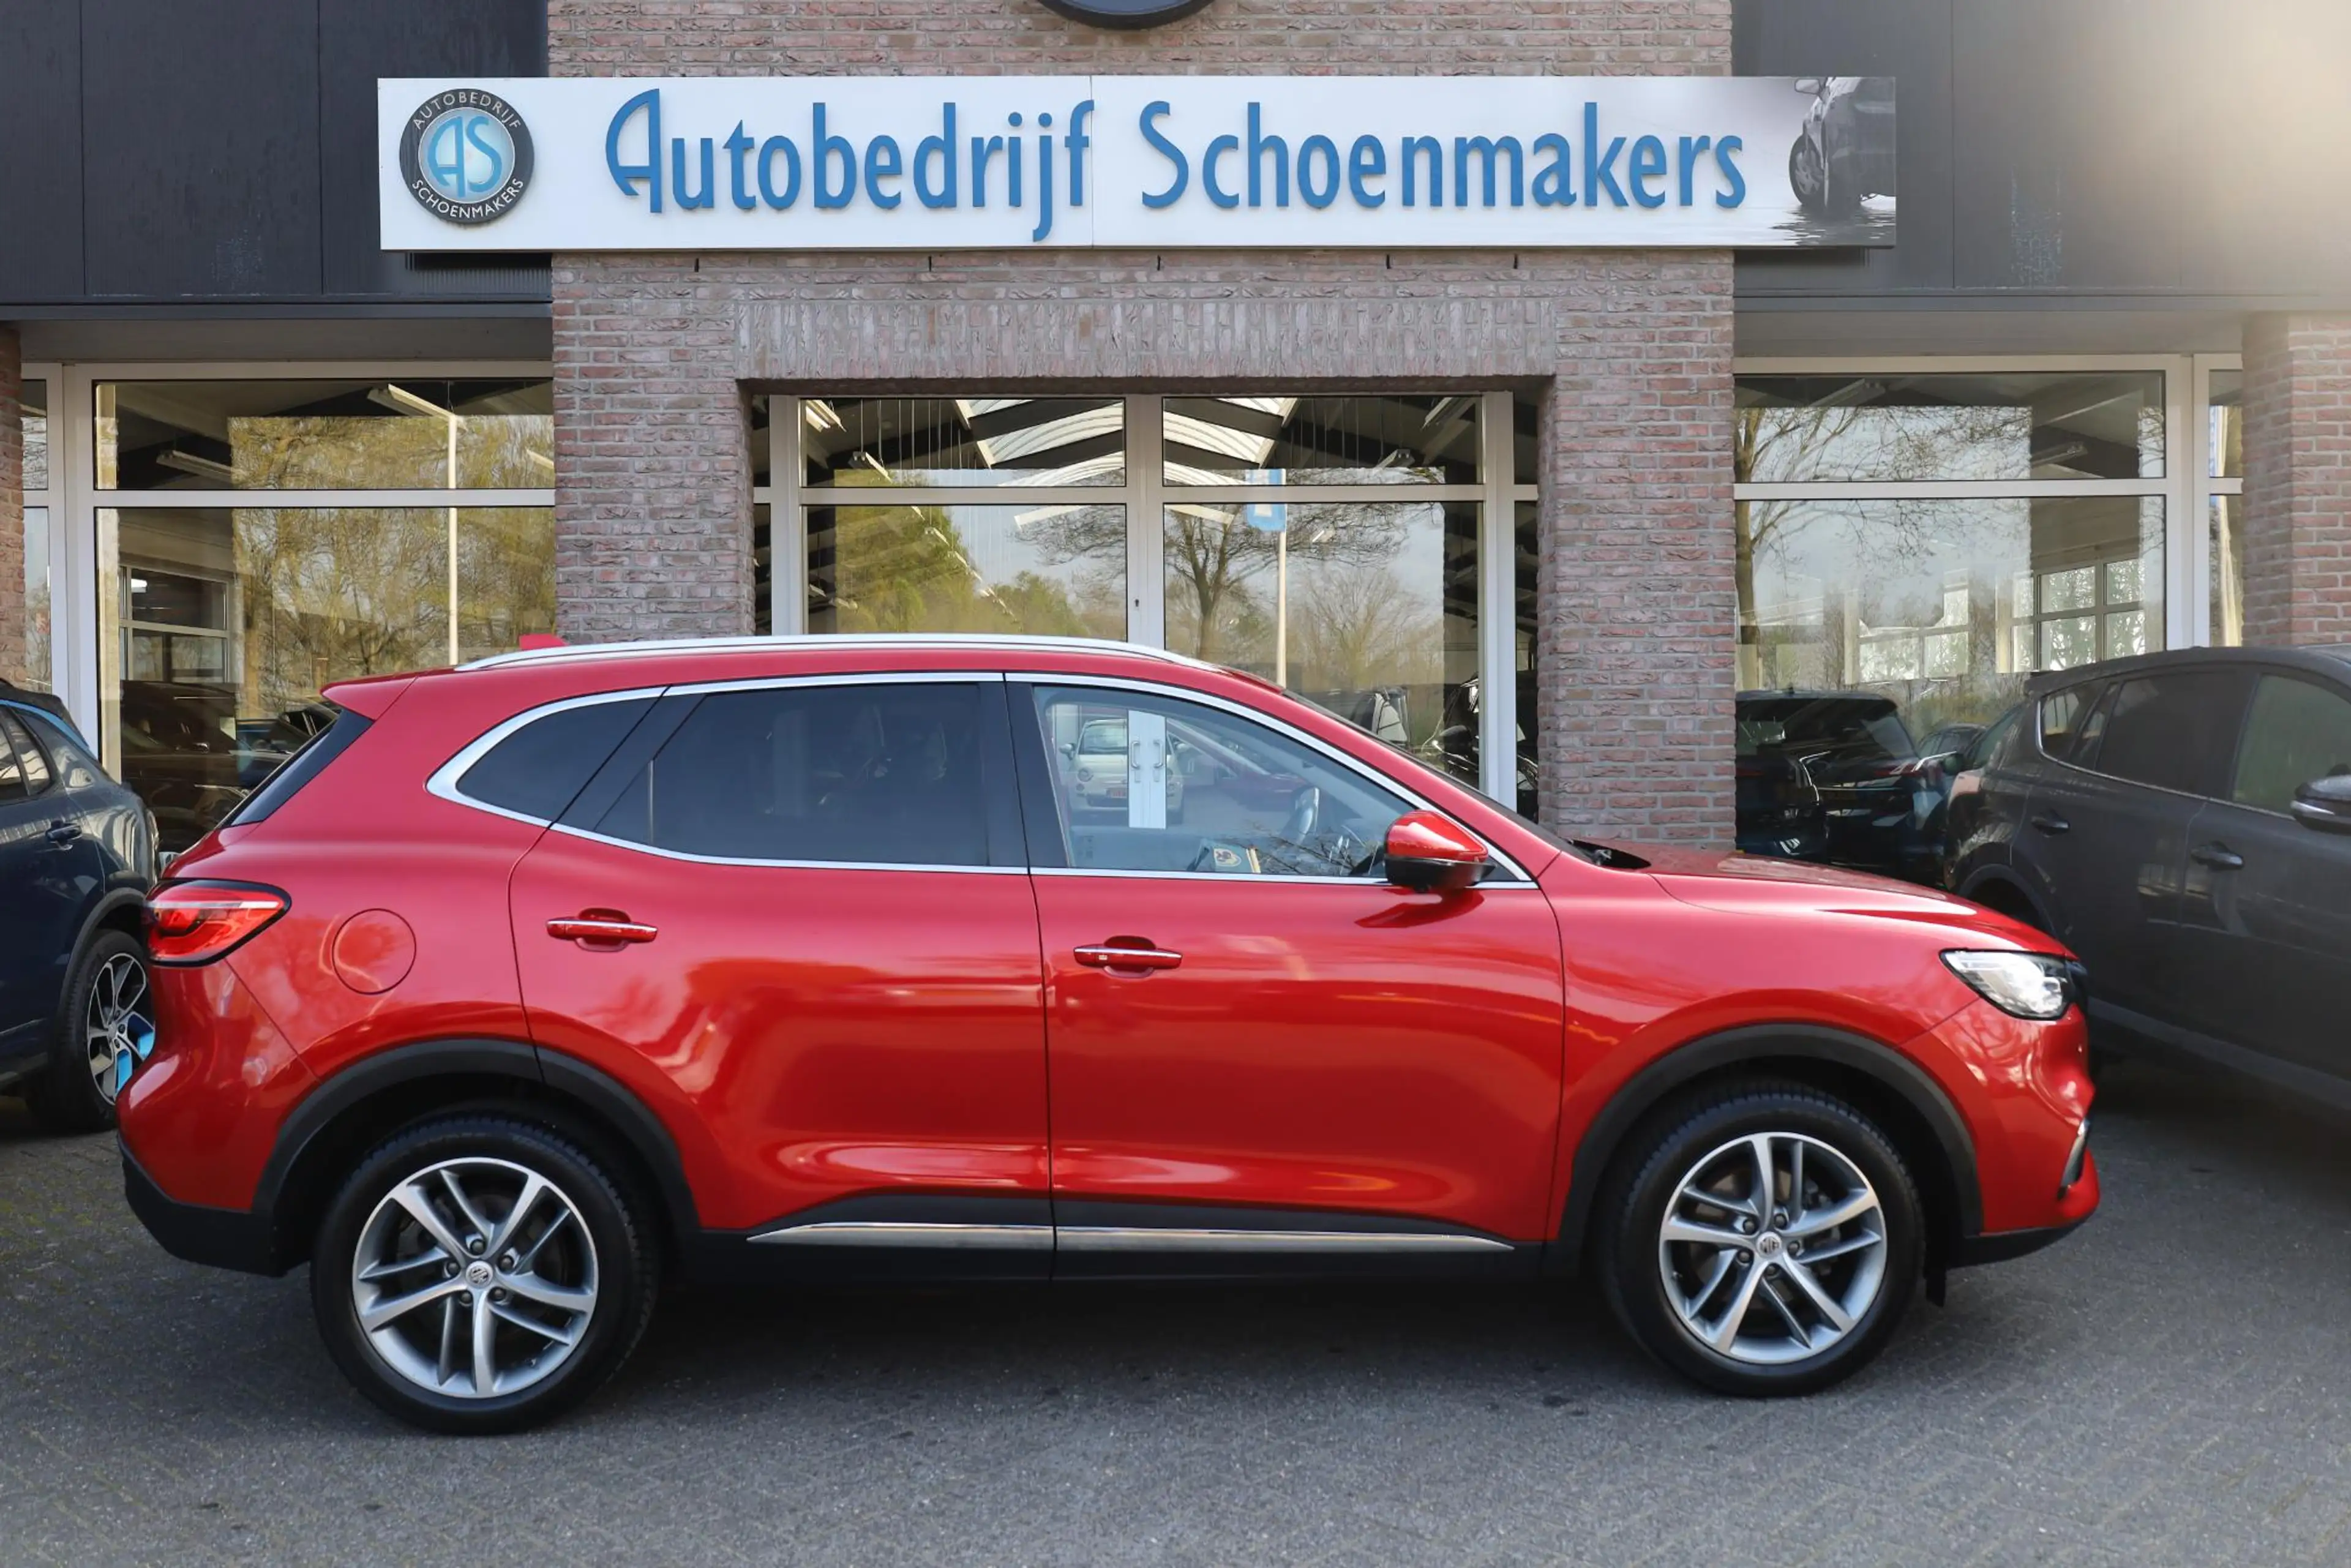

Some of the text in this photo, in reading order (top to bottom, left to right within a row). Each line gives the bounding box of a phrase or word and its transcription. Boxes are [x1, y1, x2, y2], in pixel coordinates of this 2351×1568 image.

[413, 92, 521, 130] AUTOBEDRIJF
[427, 116, 503, 197] AS
[606, 89, 1745, 241] Autobedrijf Schoenmakers
[412, 178, 523, 219] SCHOENMAKERS
